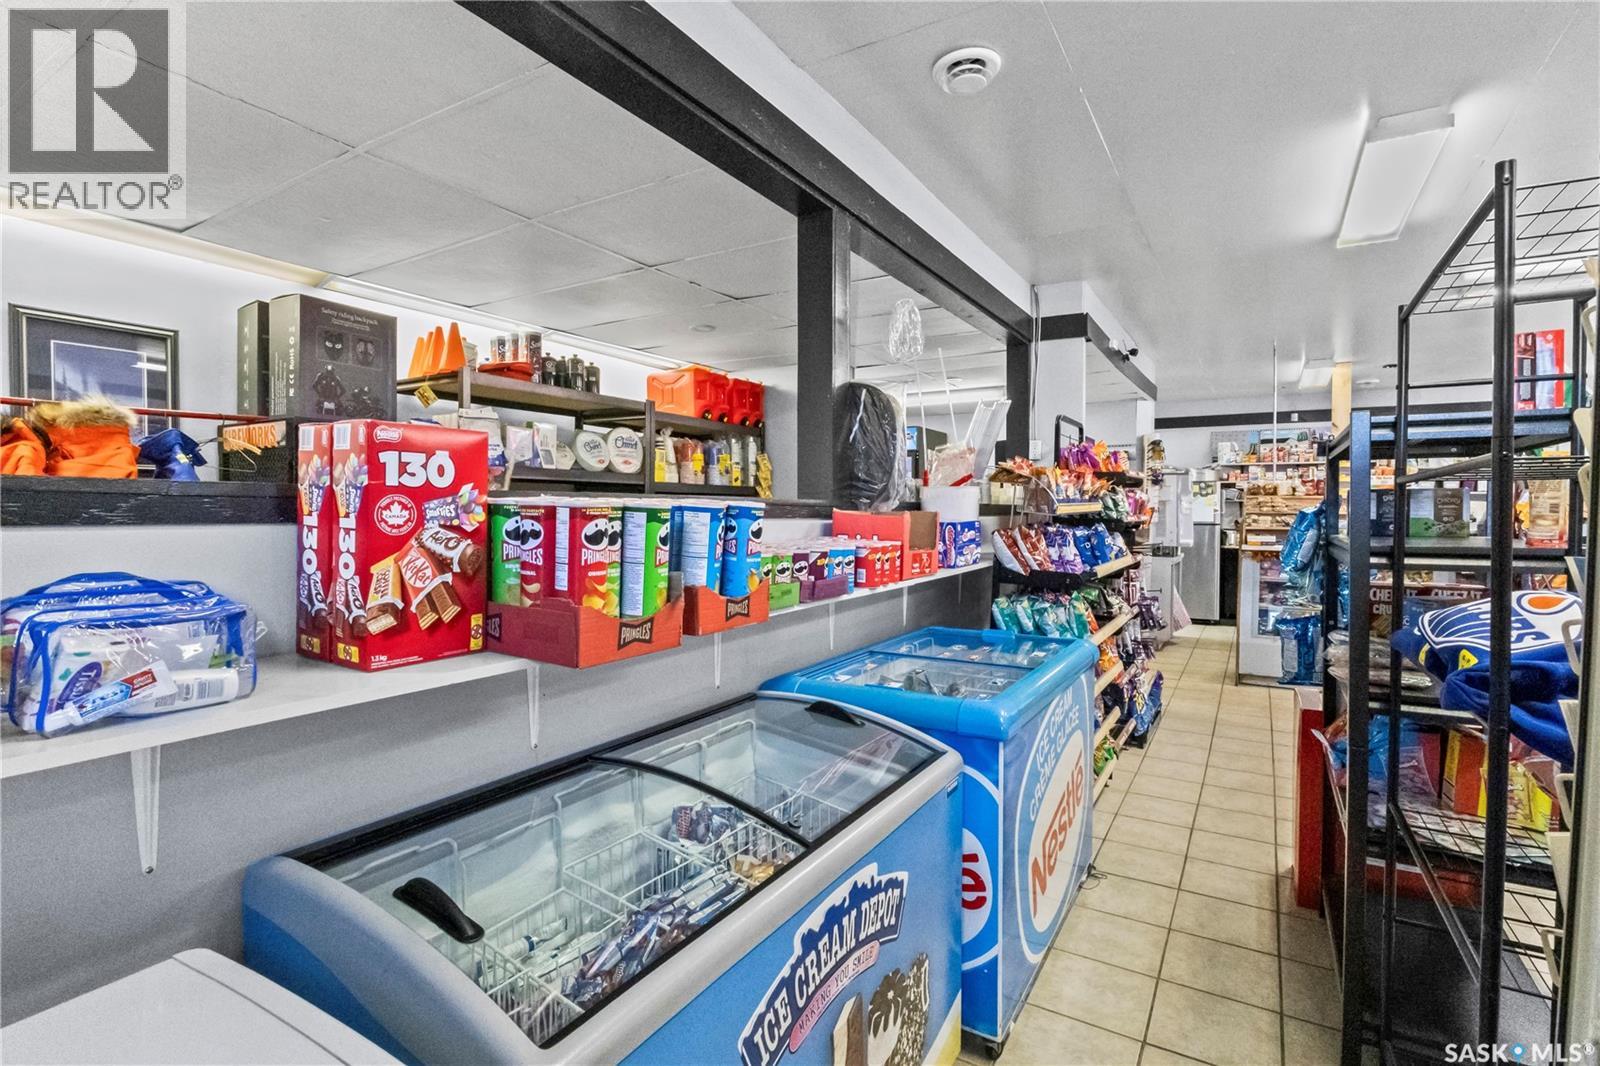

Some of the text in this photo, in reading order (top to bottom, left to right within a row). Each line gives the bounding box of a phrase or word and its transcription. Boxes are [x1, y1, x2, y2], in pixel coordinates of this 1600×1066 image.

[378, 450, 456, 489] 130
[338, 512, 357, 581] 130
[621, 622, 652, 648] PRINGLES
[1036, 686, 1073, 772] ICE CREAM
[1030, 750, 1084, 919] Nestlé
[753, 888, 901, 1066] ICE CREAM DEPOT
[798, 945, 875, 1033] MAKING YOU SMILE
